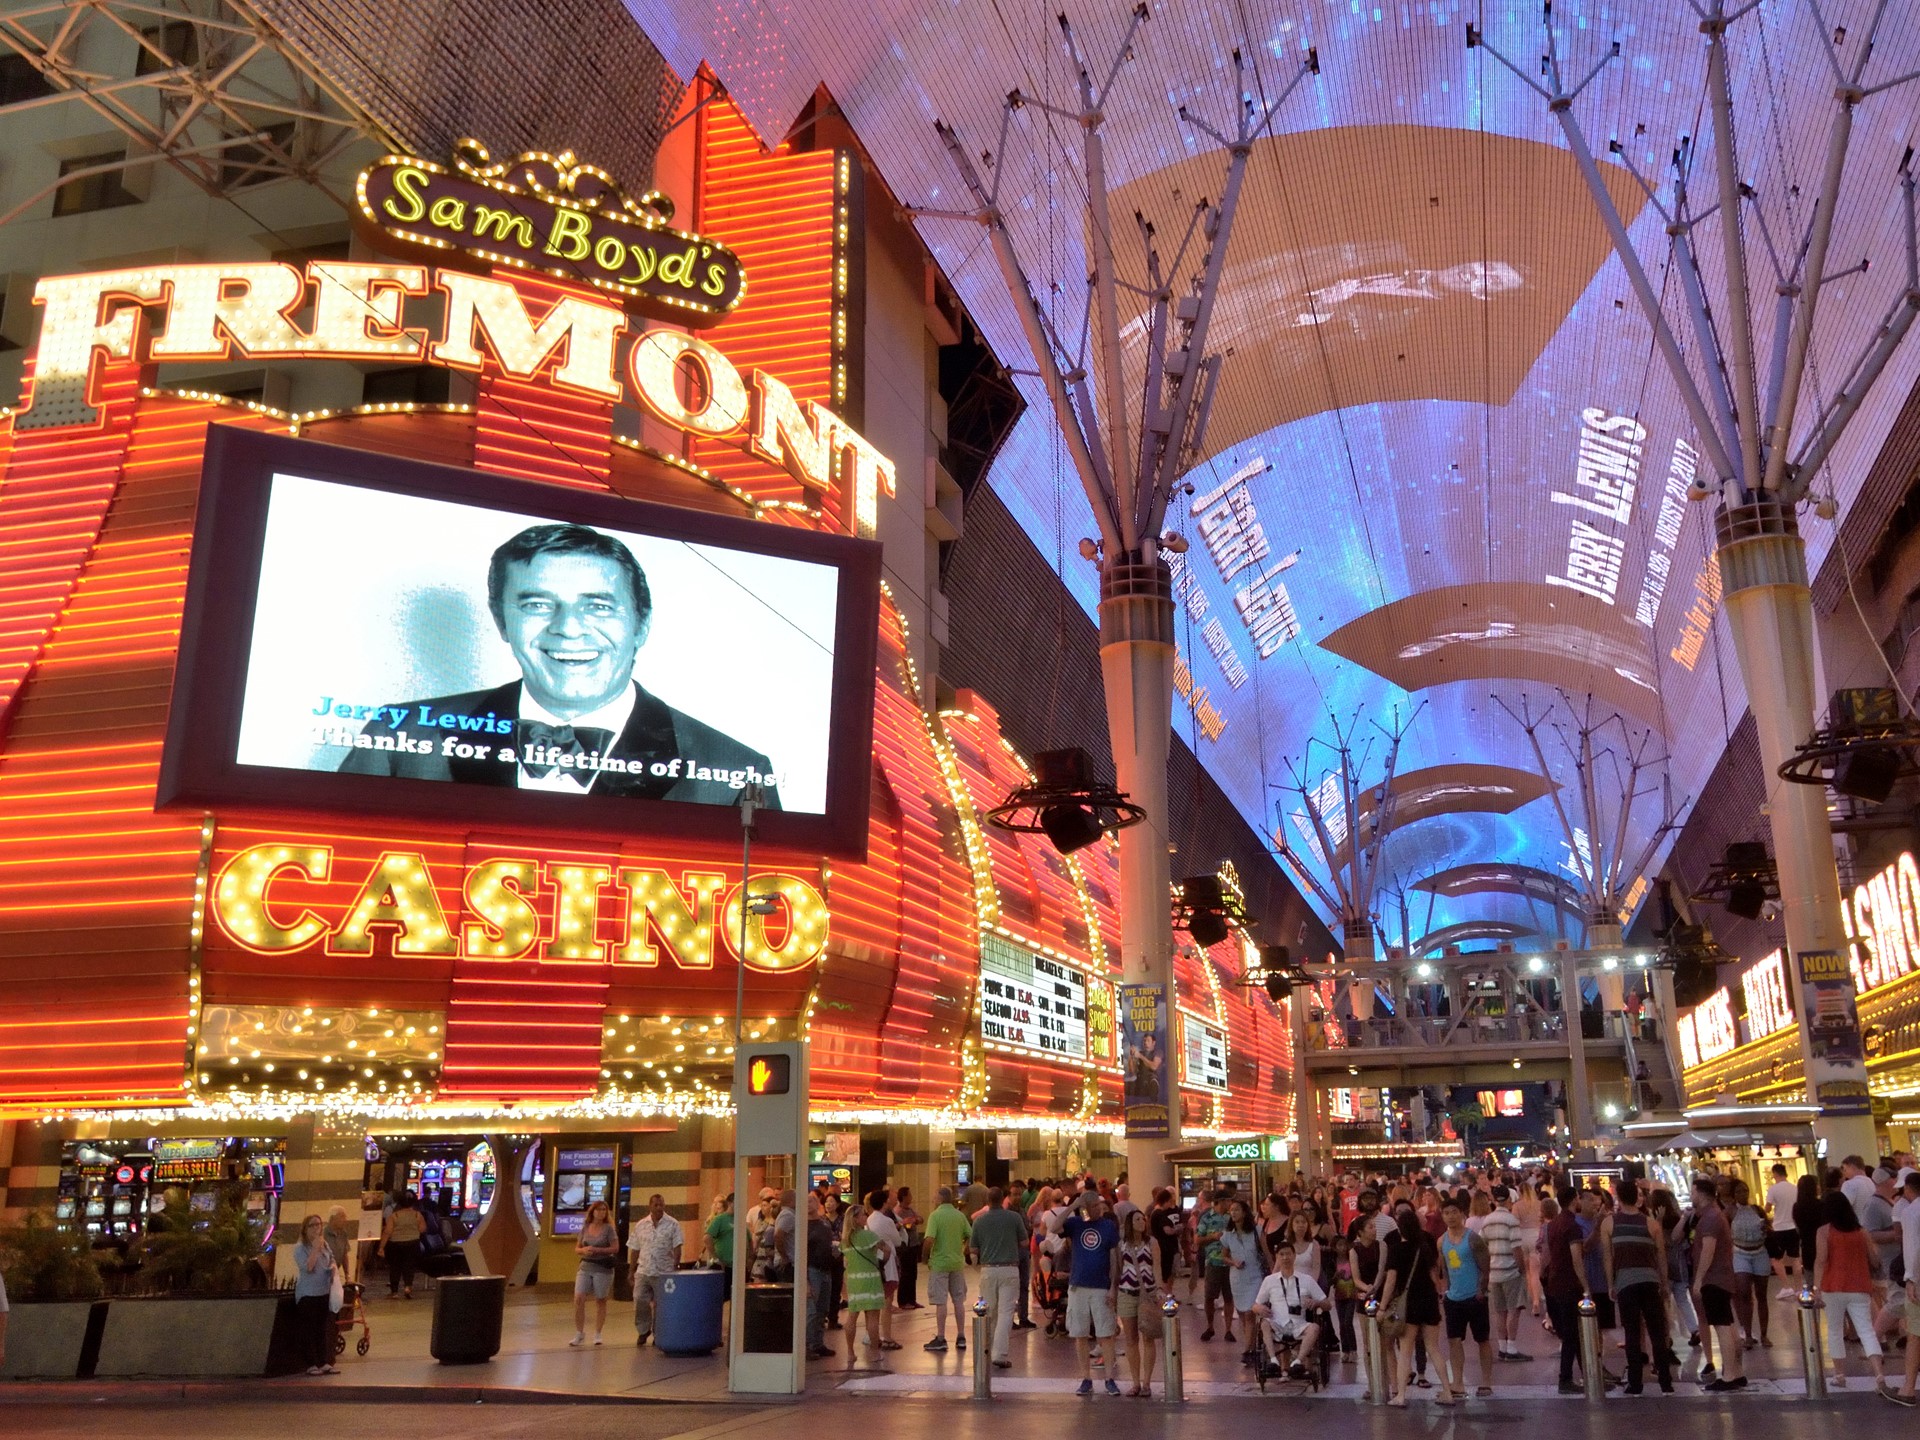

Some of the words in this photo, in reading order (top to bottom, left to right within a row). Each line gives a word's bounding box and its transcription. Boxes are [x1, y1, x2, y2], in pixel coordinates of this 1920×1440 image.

[385, 165, 540, 249] Sam
[543, 207, 728, 298] Boyd's
[13, 260, 897, 541] FREMONT
[1551, 406, 1646, 526] LEWIS
[1654, 495, 1686, 551] AUGUST
[1190, 455, 1272, 583] JERRY
[1232, 548, 1302, 661] LEWIS
[1545, 519, 1625, 606] JERRY
[1201, 616, 1232, 662] AUGUST
[312, 695, 410, 730] Jerry
[417, 705, 513, 735] Lewis
[311, 725, 434, 755] Thanks
[441, 736, 491, 761] for
[498, 747, 516, 763] a
[524, 744, 643, 775] lifetime
[650, 758, 682, 778] of
[214, 842, 830, 974] CASINO
[1803, 955, 1846, 973] NOW
[1805, 972, 1847, 982] LAUNCHING
[1124, 988, 1137, 997] WE
[1138, 987, 1162, 996] TRIPLE
[1132, 996, 1155, 1008] DOG
[985, 999, 1012, 1020] SEAFOOD
[1089, 1008, 1113, 1034] SPORTS
[1130, 1008, 1158, 1020] DARE
[985, 1020, 1006, 1039] STEAK
[1133, 1020, 1156, 1033] YOU
[1214, 1143, 1260, 1159] CIGARS
